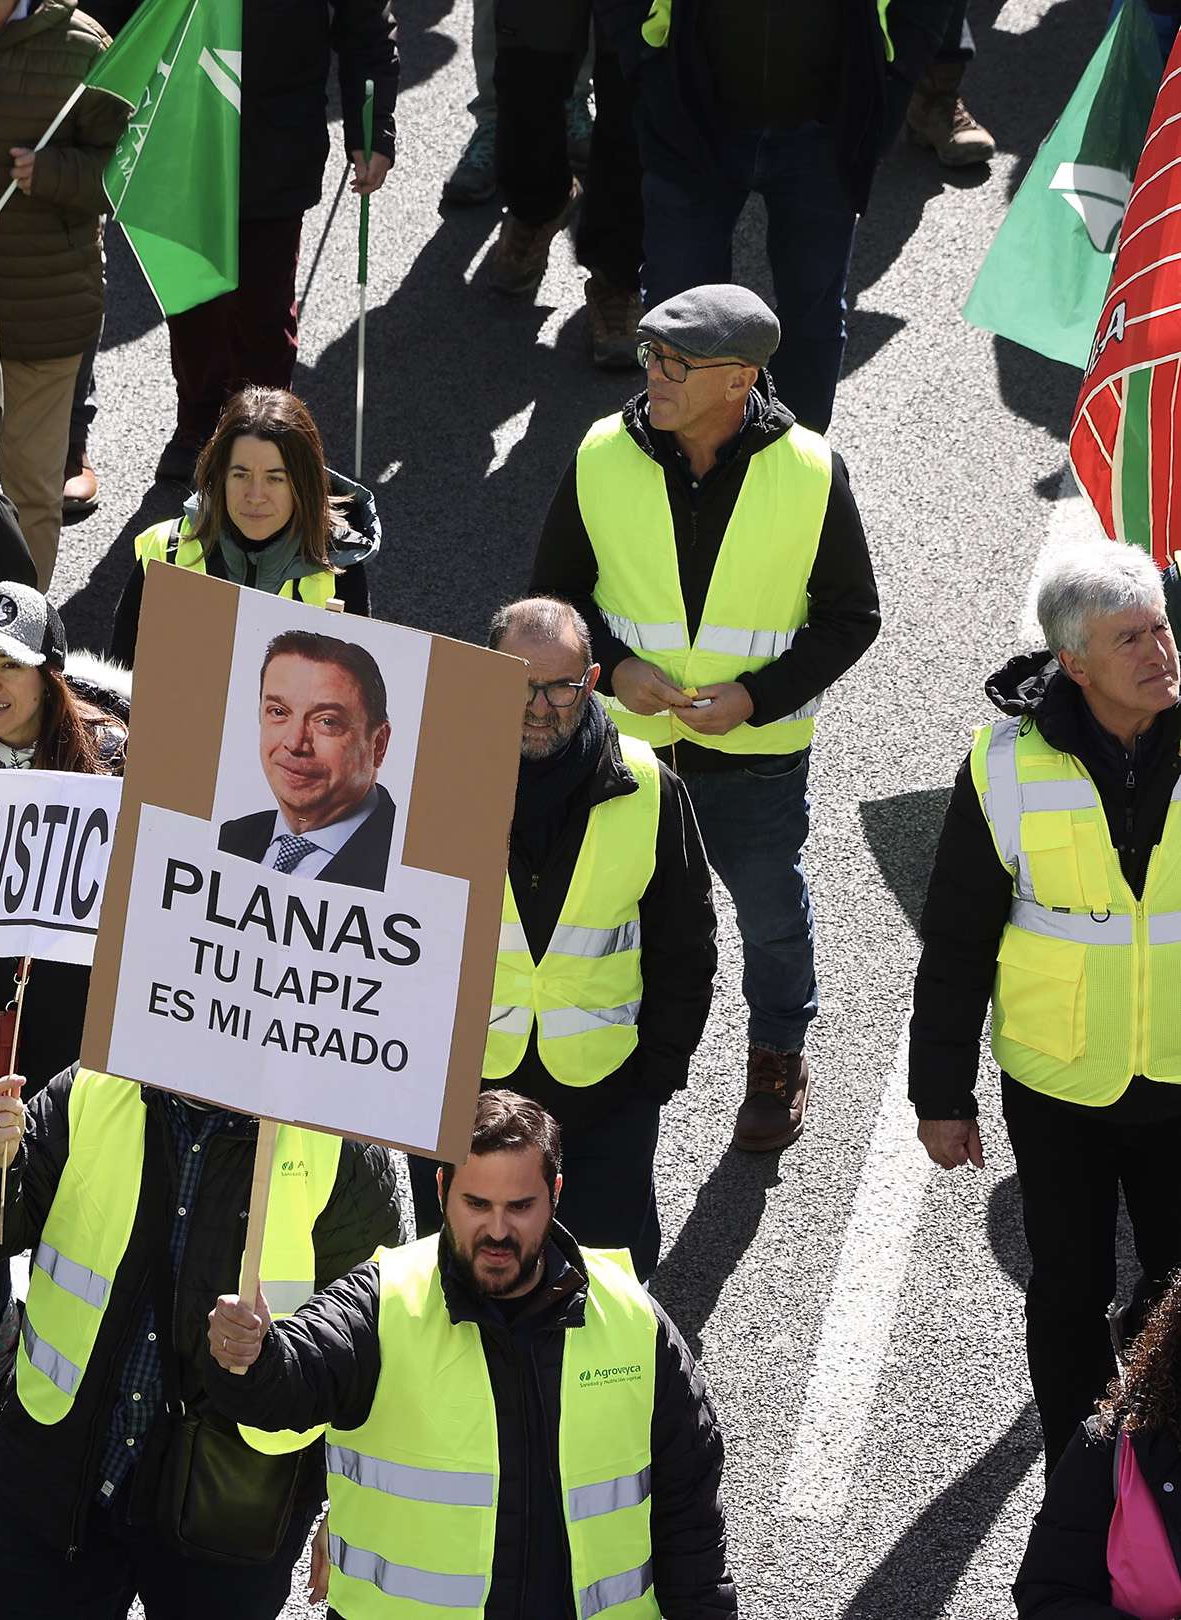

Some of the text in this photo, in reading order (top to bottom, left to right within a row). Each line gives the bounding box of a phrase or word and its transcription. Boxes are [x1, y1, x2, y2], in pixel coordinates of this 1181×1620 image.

[161, 857, 422, 966] PLANAS
[189, 936, 383, 1016] TU LAPIZ
[148, 982, 409, 1072] ES MI ARADO
